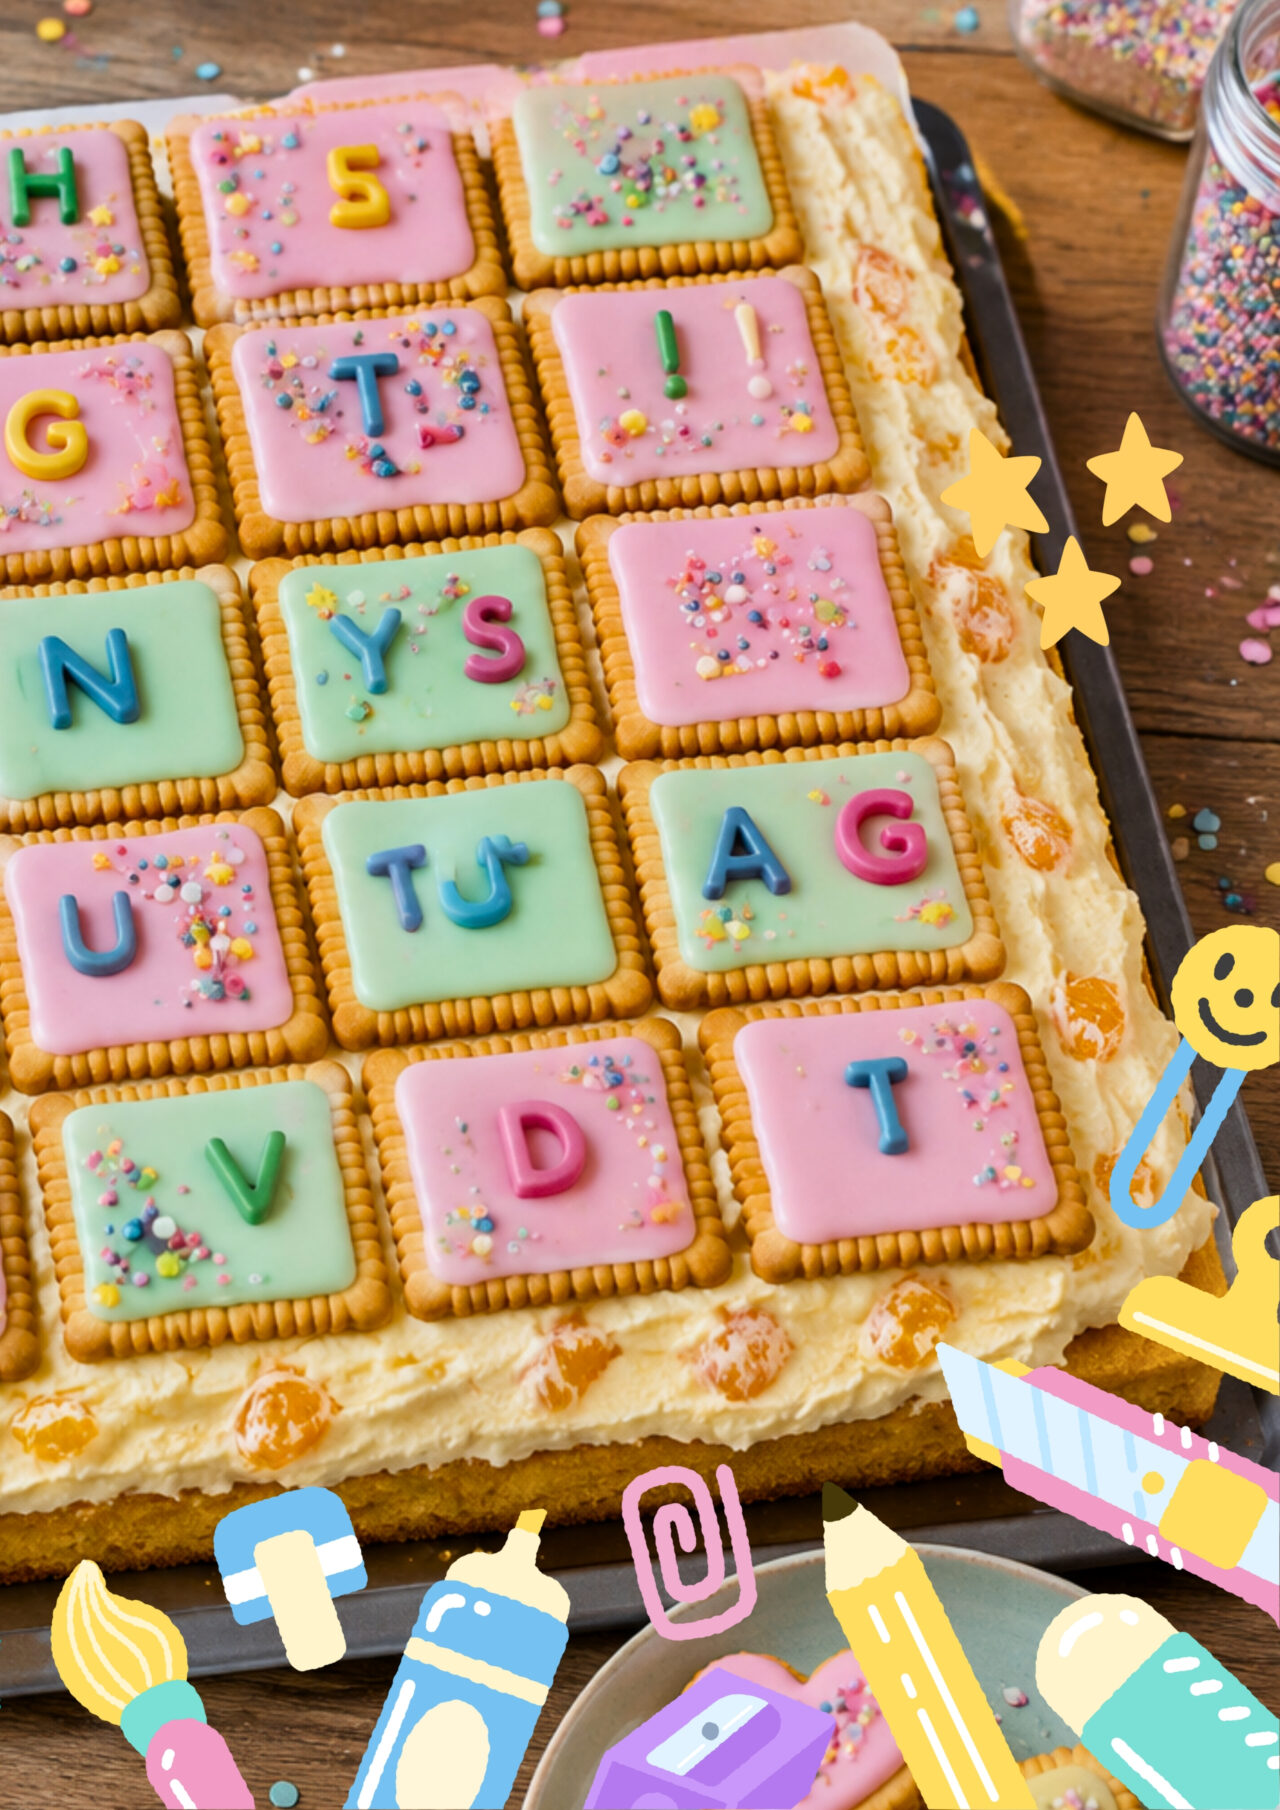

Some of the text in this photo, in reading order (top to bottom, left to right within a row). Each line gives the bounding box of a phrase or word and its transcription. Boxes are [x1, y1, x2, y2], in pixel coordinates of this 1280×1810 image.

[8, 146, 79, 228] H
[5, 389, 88, 482] G
[329, 352, 400, 437] T
[204, 1130, 287, 1226] V
[498, 1100, 588, 1199] D
[844, 1056, 909, 1156] T
